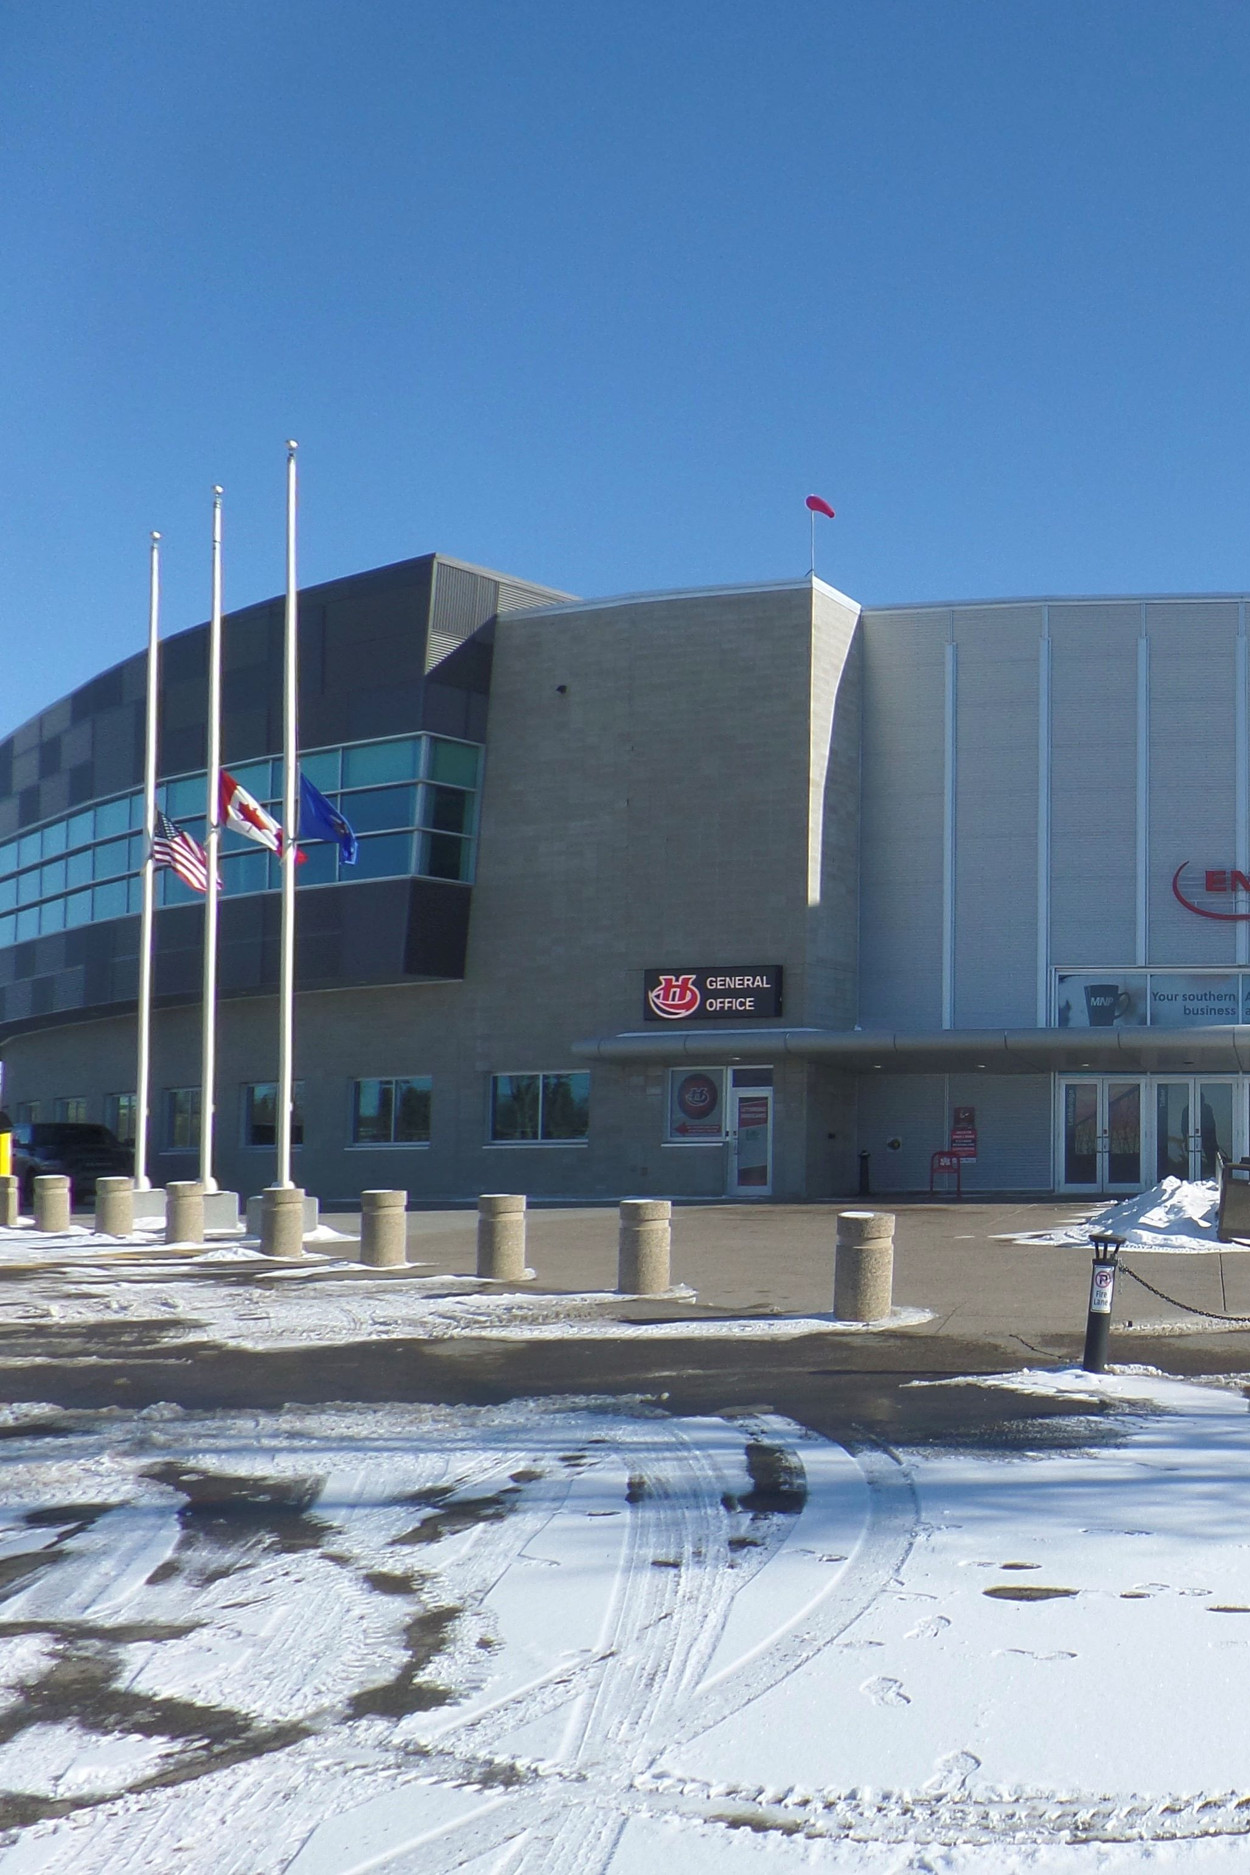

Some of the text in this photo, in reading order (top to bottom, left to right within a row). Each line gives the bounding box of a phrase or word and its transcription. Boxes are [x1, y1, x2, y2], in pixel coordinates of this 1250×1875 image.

[706, 976, 771, 989] GENERAL
[1090, 997, 1114, 1007] MNP
[1151, 991, 1179, 1002] Your
[1182, 991, 1236, 1002] southern
[706, 998, 755, 1011] OFFICE
[1183, 1005, 1236, 1016] business
[1095, 1290, 1108, 1298] Fire
[1094, 1298, 1108, 1306] Lane
